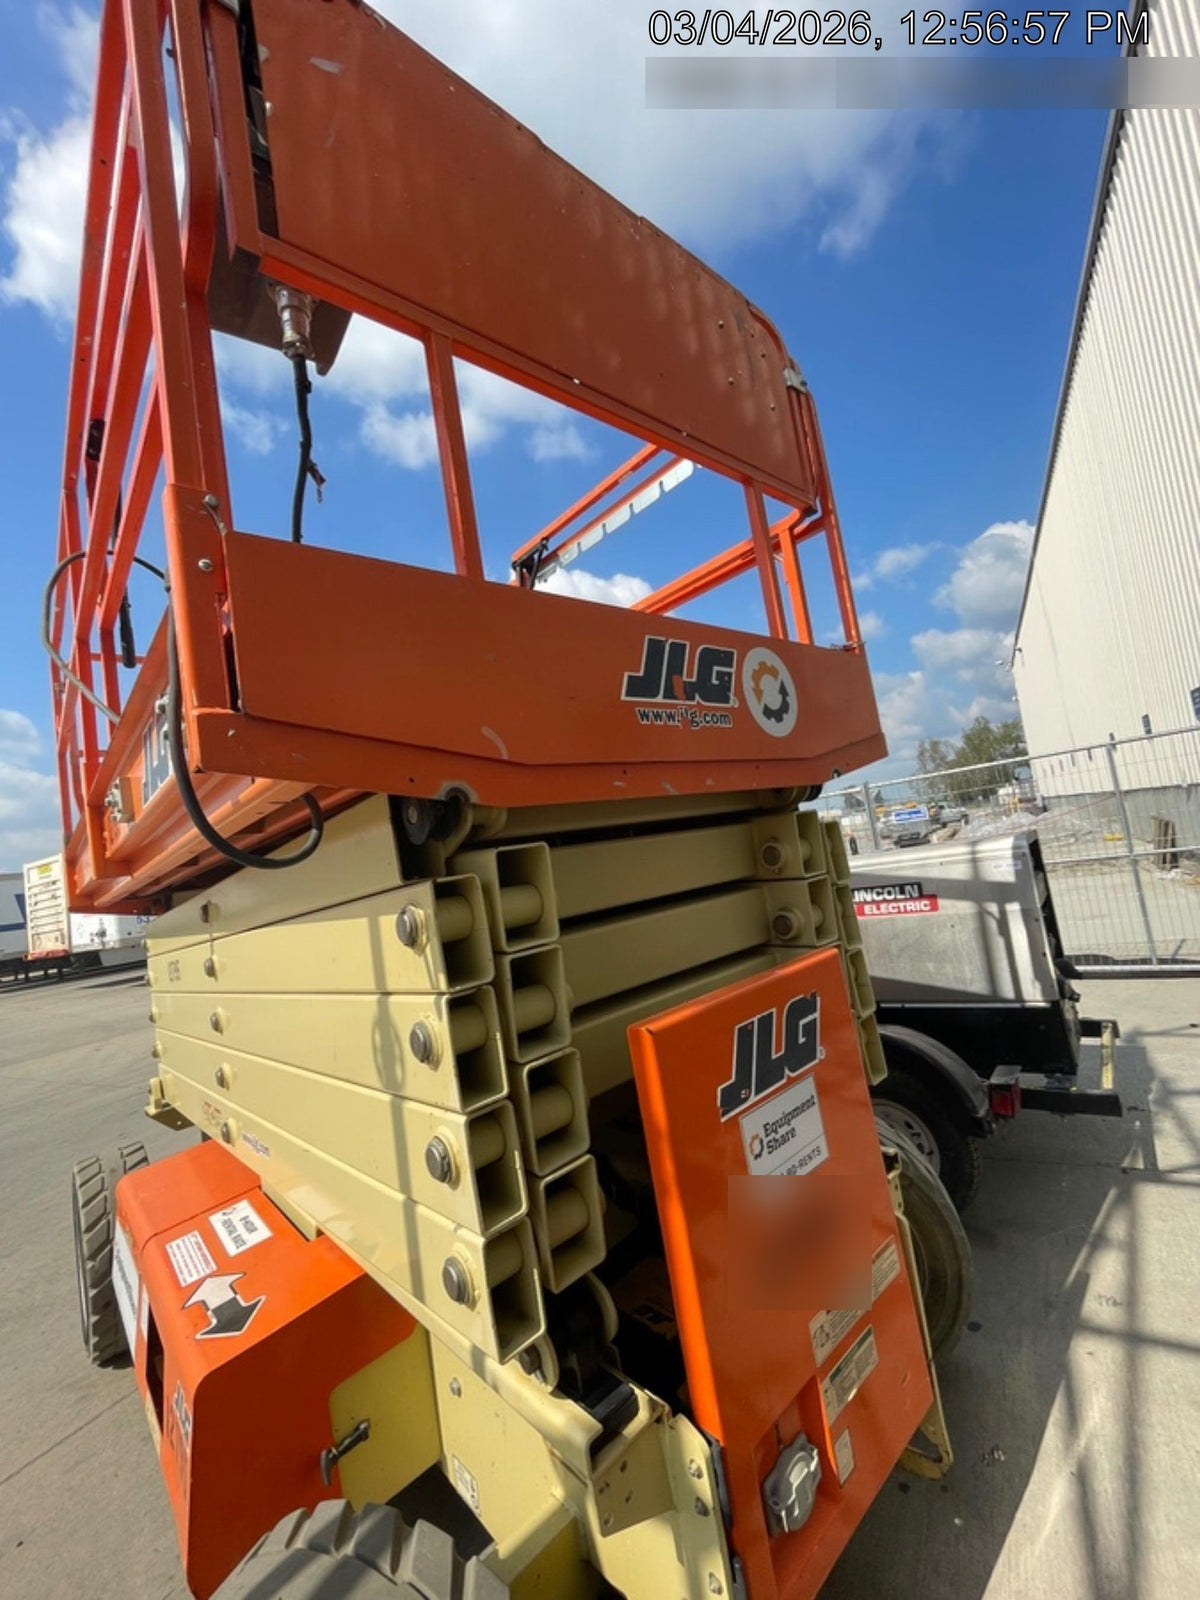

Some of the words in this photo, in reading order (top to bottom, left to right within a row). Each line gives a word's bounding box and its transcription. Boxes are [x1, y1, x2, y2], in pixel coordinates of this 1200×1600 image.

[621, 635, 738, 706] JLG
[636, 707, 732, 729] www.jlg.com
[864, 900, 931, 915] ELECTRIC
[717, 991, 820, 1122] JLG
[763, 1095, 816, 1138] Equipment
[766, 1126, 797, 1155] Share
